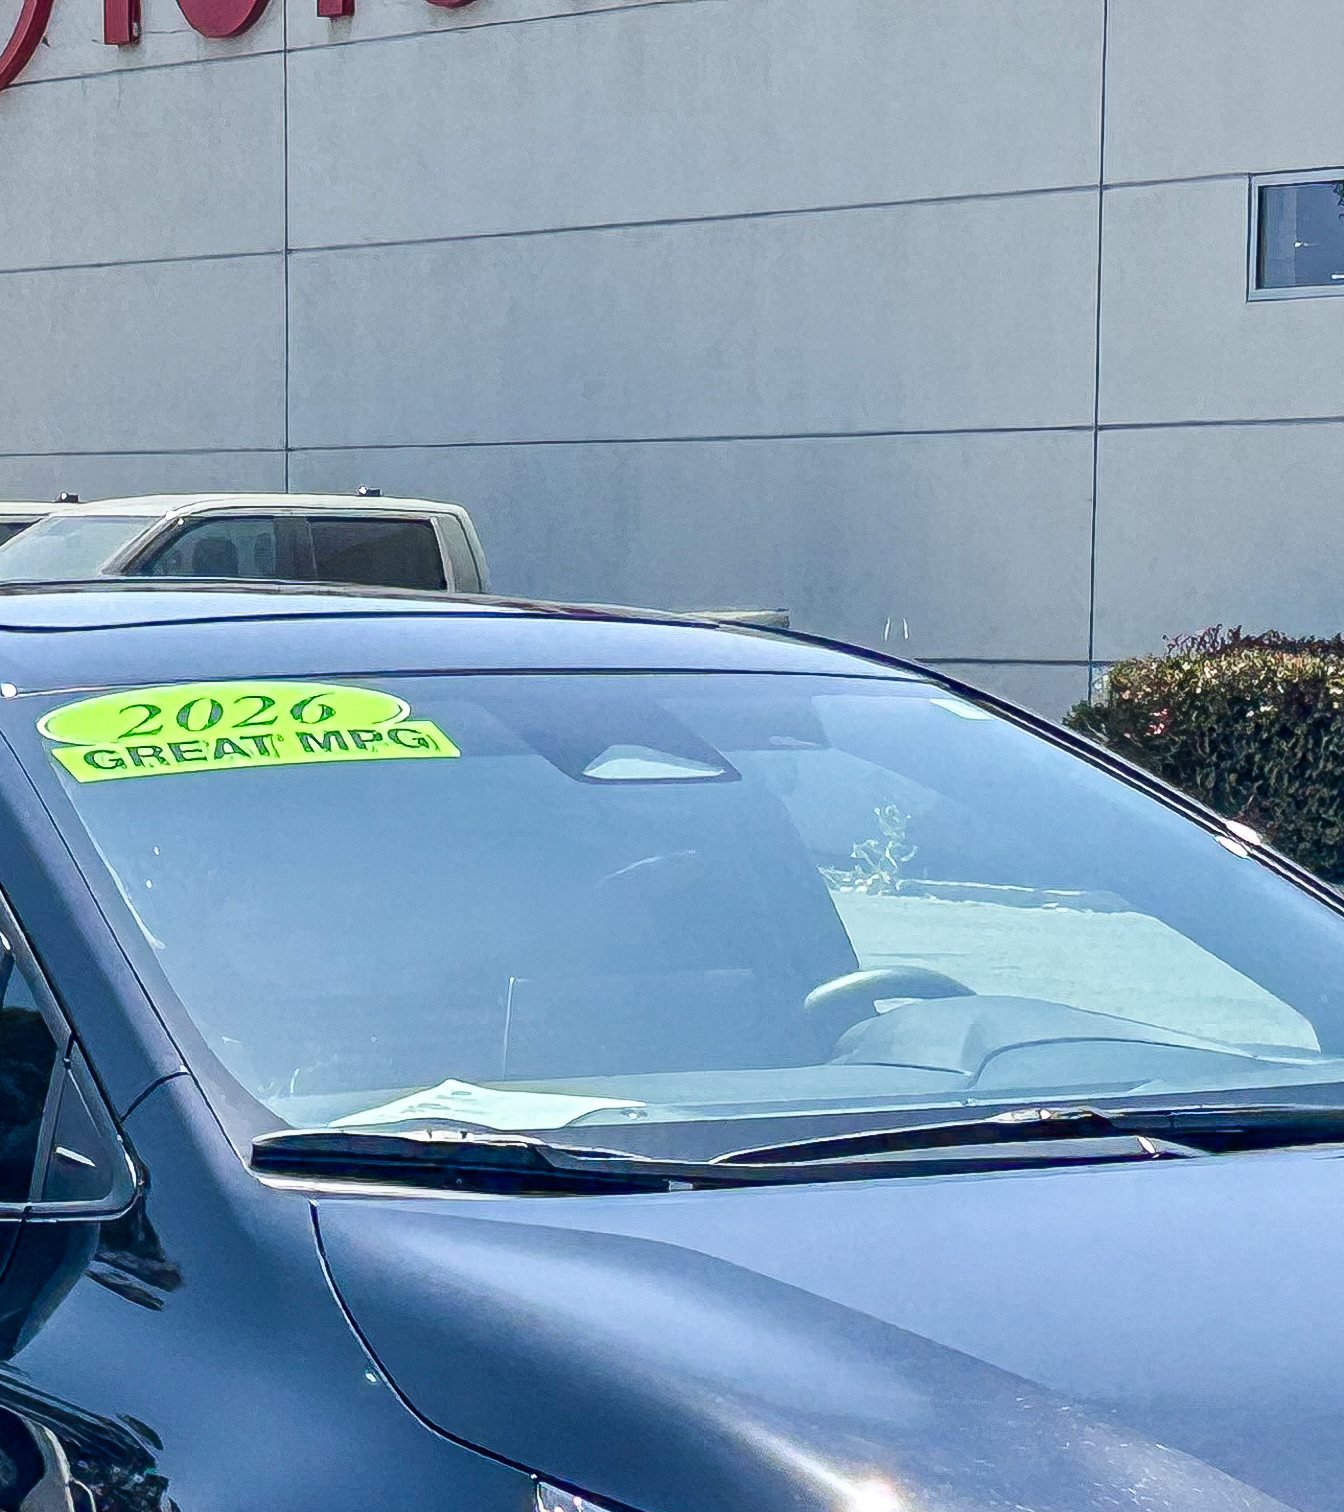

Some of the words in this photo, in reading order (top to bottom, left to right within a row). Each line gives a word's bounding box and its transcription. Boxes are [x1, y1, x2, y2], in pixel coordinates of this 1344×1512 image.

[117, 692, 337, 739] 2026
[83, 733, 272, 771] GREAT
[295, 728, 430, 753] MPG
